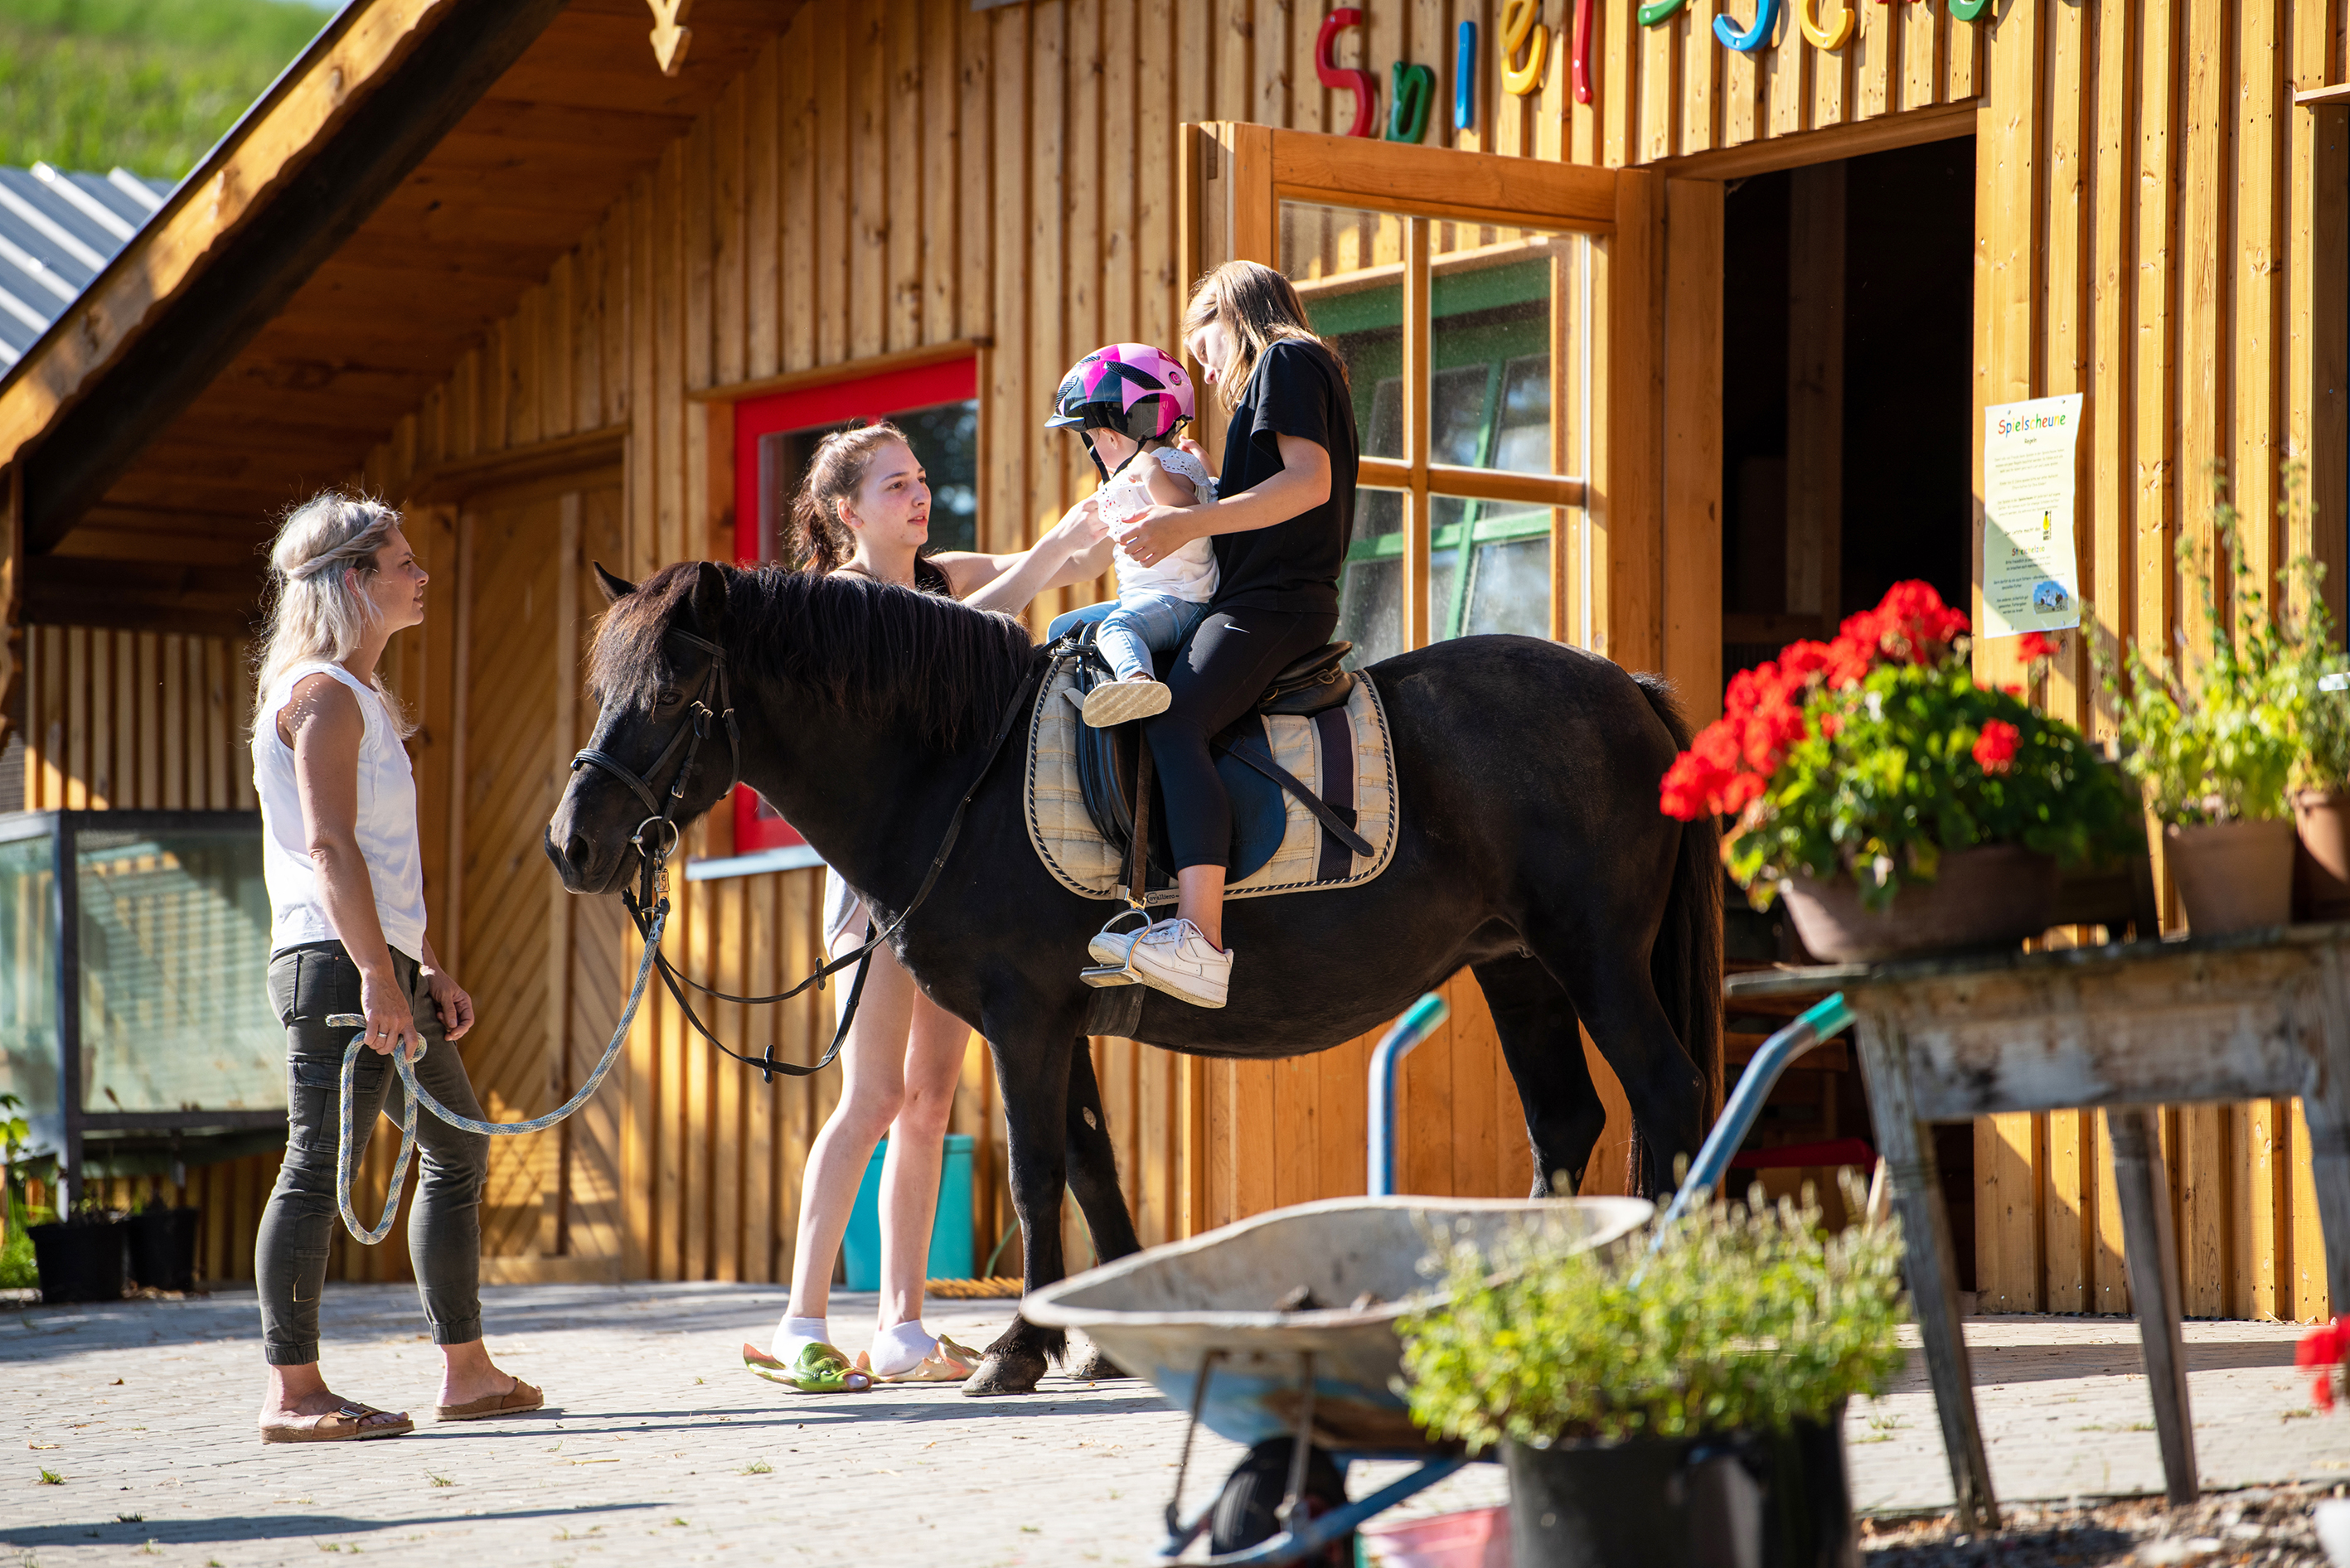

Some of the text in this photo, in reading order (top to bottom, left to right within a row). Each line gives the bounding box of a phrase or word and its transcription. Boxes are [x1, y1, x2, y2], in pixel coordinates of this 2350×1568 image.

[1998, 414, 2066, 438] Spielscheune
[2012, 544, 2045, 556] Streichelzoo
[1146, 892, 1175, 904] Covalliero
